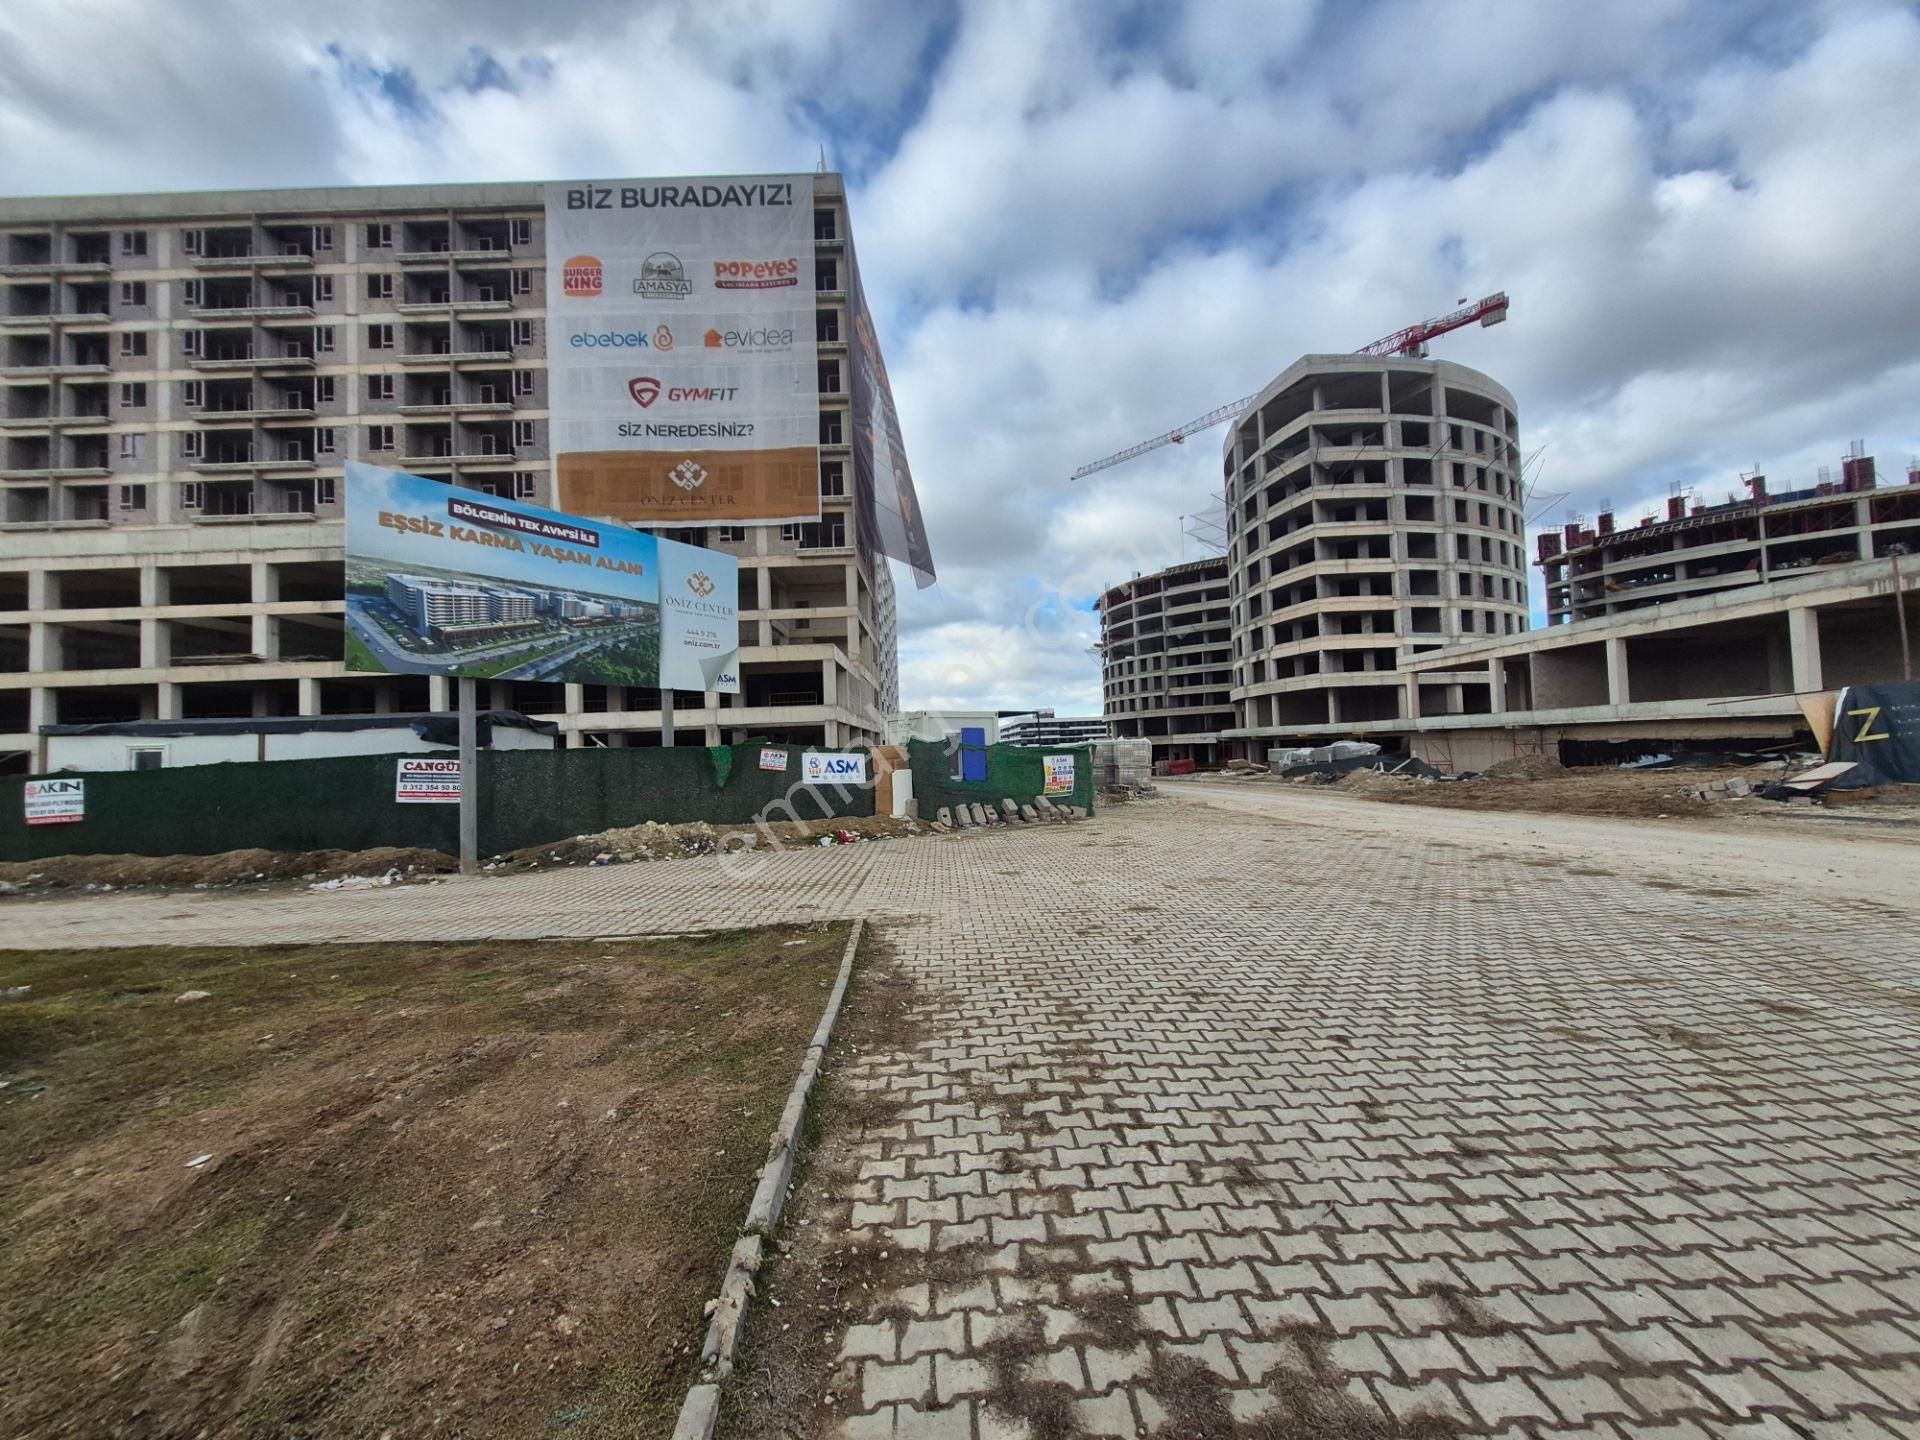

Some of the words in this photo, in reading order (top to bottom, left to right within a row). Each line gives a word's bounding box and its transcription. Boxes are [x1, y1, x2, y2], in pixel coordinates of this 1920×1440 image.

[567, 184, 612, 210] BİZ
[621, 183, 793, 208] BURADAYIZ!
[563, 268, 602, 277] BURGER
[563, 277, 602, 289] KING
[637, 282, 689, 292] AMASYA
[570, 331, 649, 347] ebebek
[724, 328, 793, 347] evidea
[668, 387, 738, 402] GYMFIT
[618, 422, 641, 437] SİZ
[646, 421, 754, 437] NEREDESİNİZ?
[453, 502, 516, 526] BÖLGENİN
[518, 518, 540, 532] TEK
[581, 530, 596, 544] İLE
[378, 511, 444, 538] EŞSİZ
[450, 525, 525, 553] KARMA
[528, 541, 592, 565] YAŞAM
[596, 556, 643, 576] ALANI
[717, 674, 736, 683] ASM
[1847, 707, 1889, 742] Z
[824, 759, 860, 773] ASM
